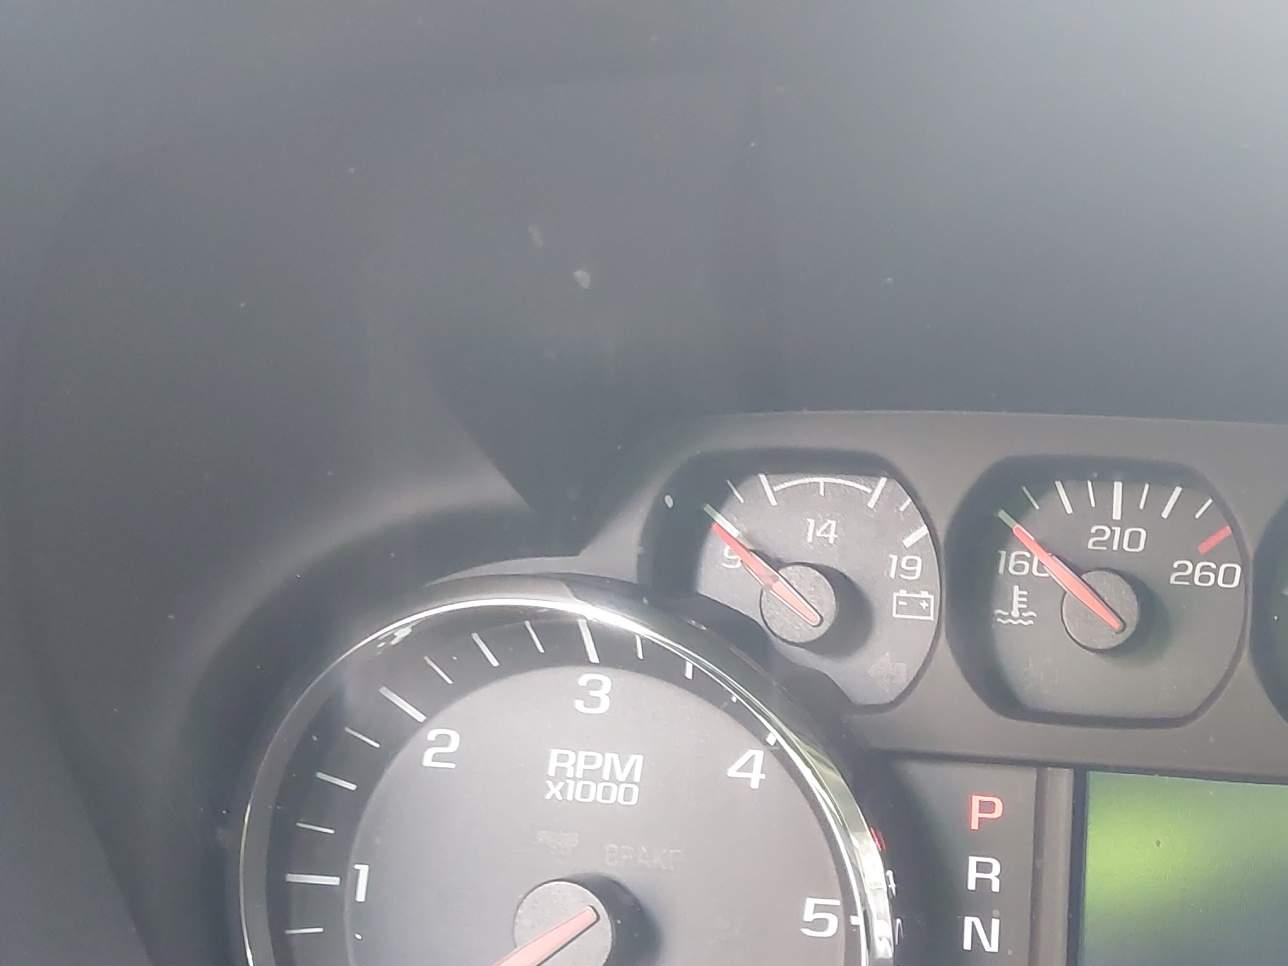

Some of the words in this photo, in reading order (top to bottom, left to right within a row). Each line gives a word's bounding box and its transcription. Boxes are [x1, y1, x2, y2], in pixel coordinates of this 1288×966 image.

[806, 518, 839, 544] 14
[1087, 525, 1147, 553] 210
[888, 553, 922, 580] 19
[1169, 560, 1242, 588] 260
[573, 673, 612, 714] 3
[422, 728, 460, 769] 2
[546, 748, 644, 782] RPM
[726, 749, 766, 789] 4
[970, 795, 1003, 830] P
[353, 864, 369, 902] 1
[967, 855, 1001, 893] R
[799, 897, 841, 938] 5
[963, 916, 1000, 953] N
